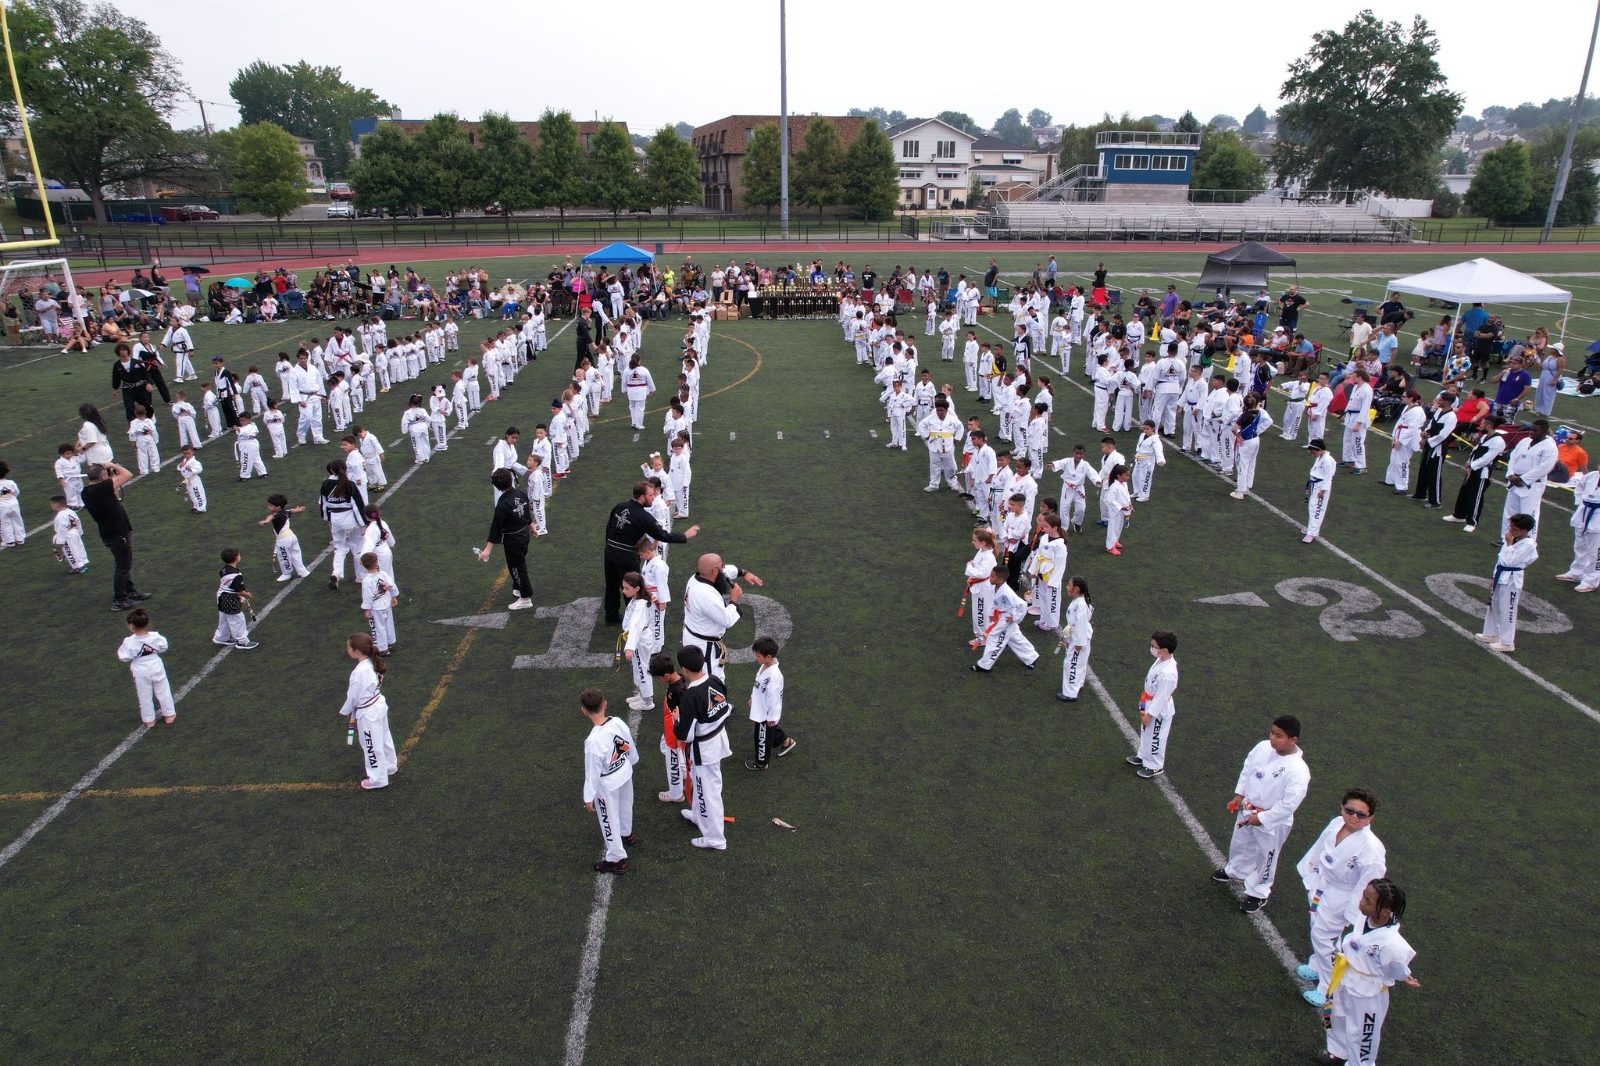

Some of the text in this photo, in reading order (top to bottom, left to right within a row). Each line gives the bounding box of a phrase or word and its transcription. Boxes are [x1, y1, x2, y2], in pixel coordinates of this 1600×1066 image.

[990, 630, 1007, 660] ZENTAI
[1068, 651, 1079, 684] ZENTAI
[364, 730, 378, 768] ZENTAI
[758, 723, 767, 761] ZENTAI
[1151, 718, 1162, 755] ZENTAI
[670, 750, 680, 785] ZENTAI
[695, 776, 708, 818] ZENTAI
[598, 798, 613, 842] ZENTAI
